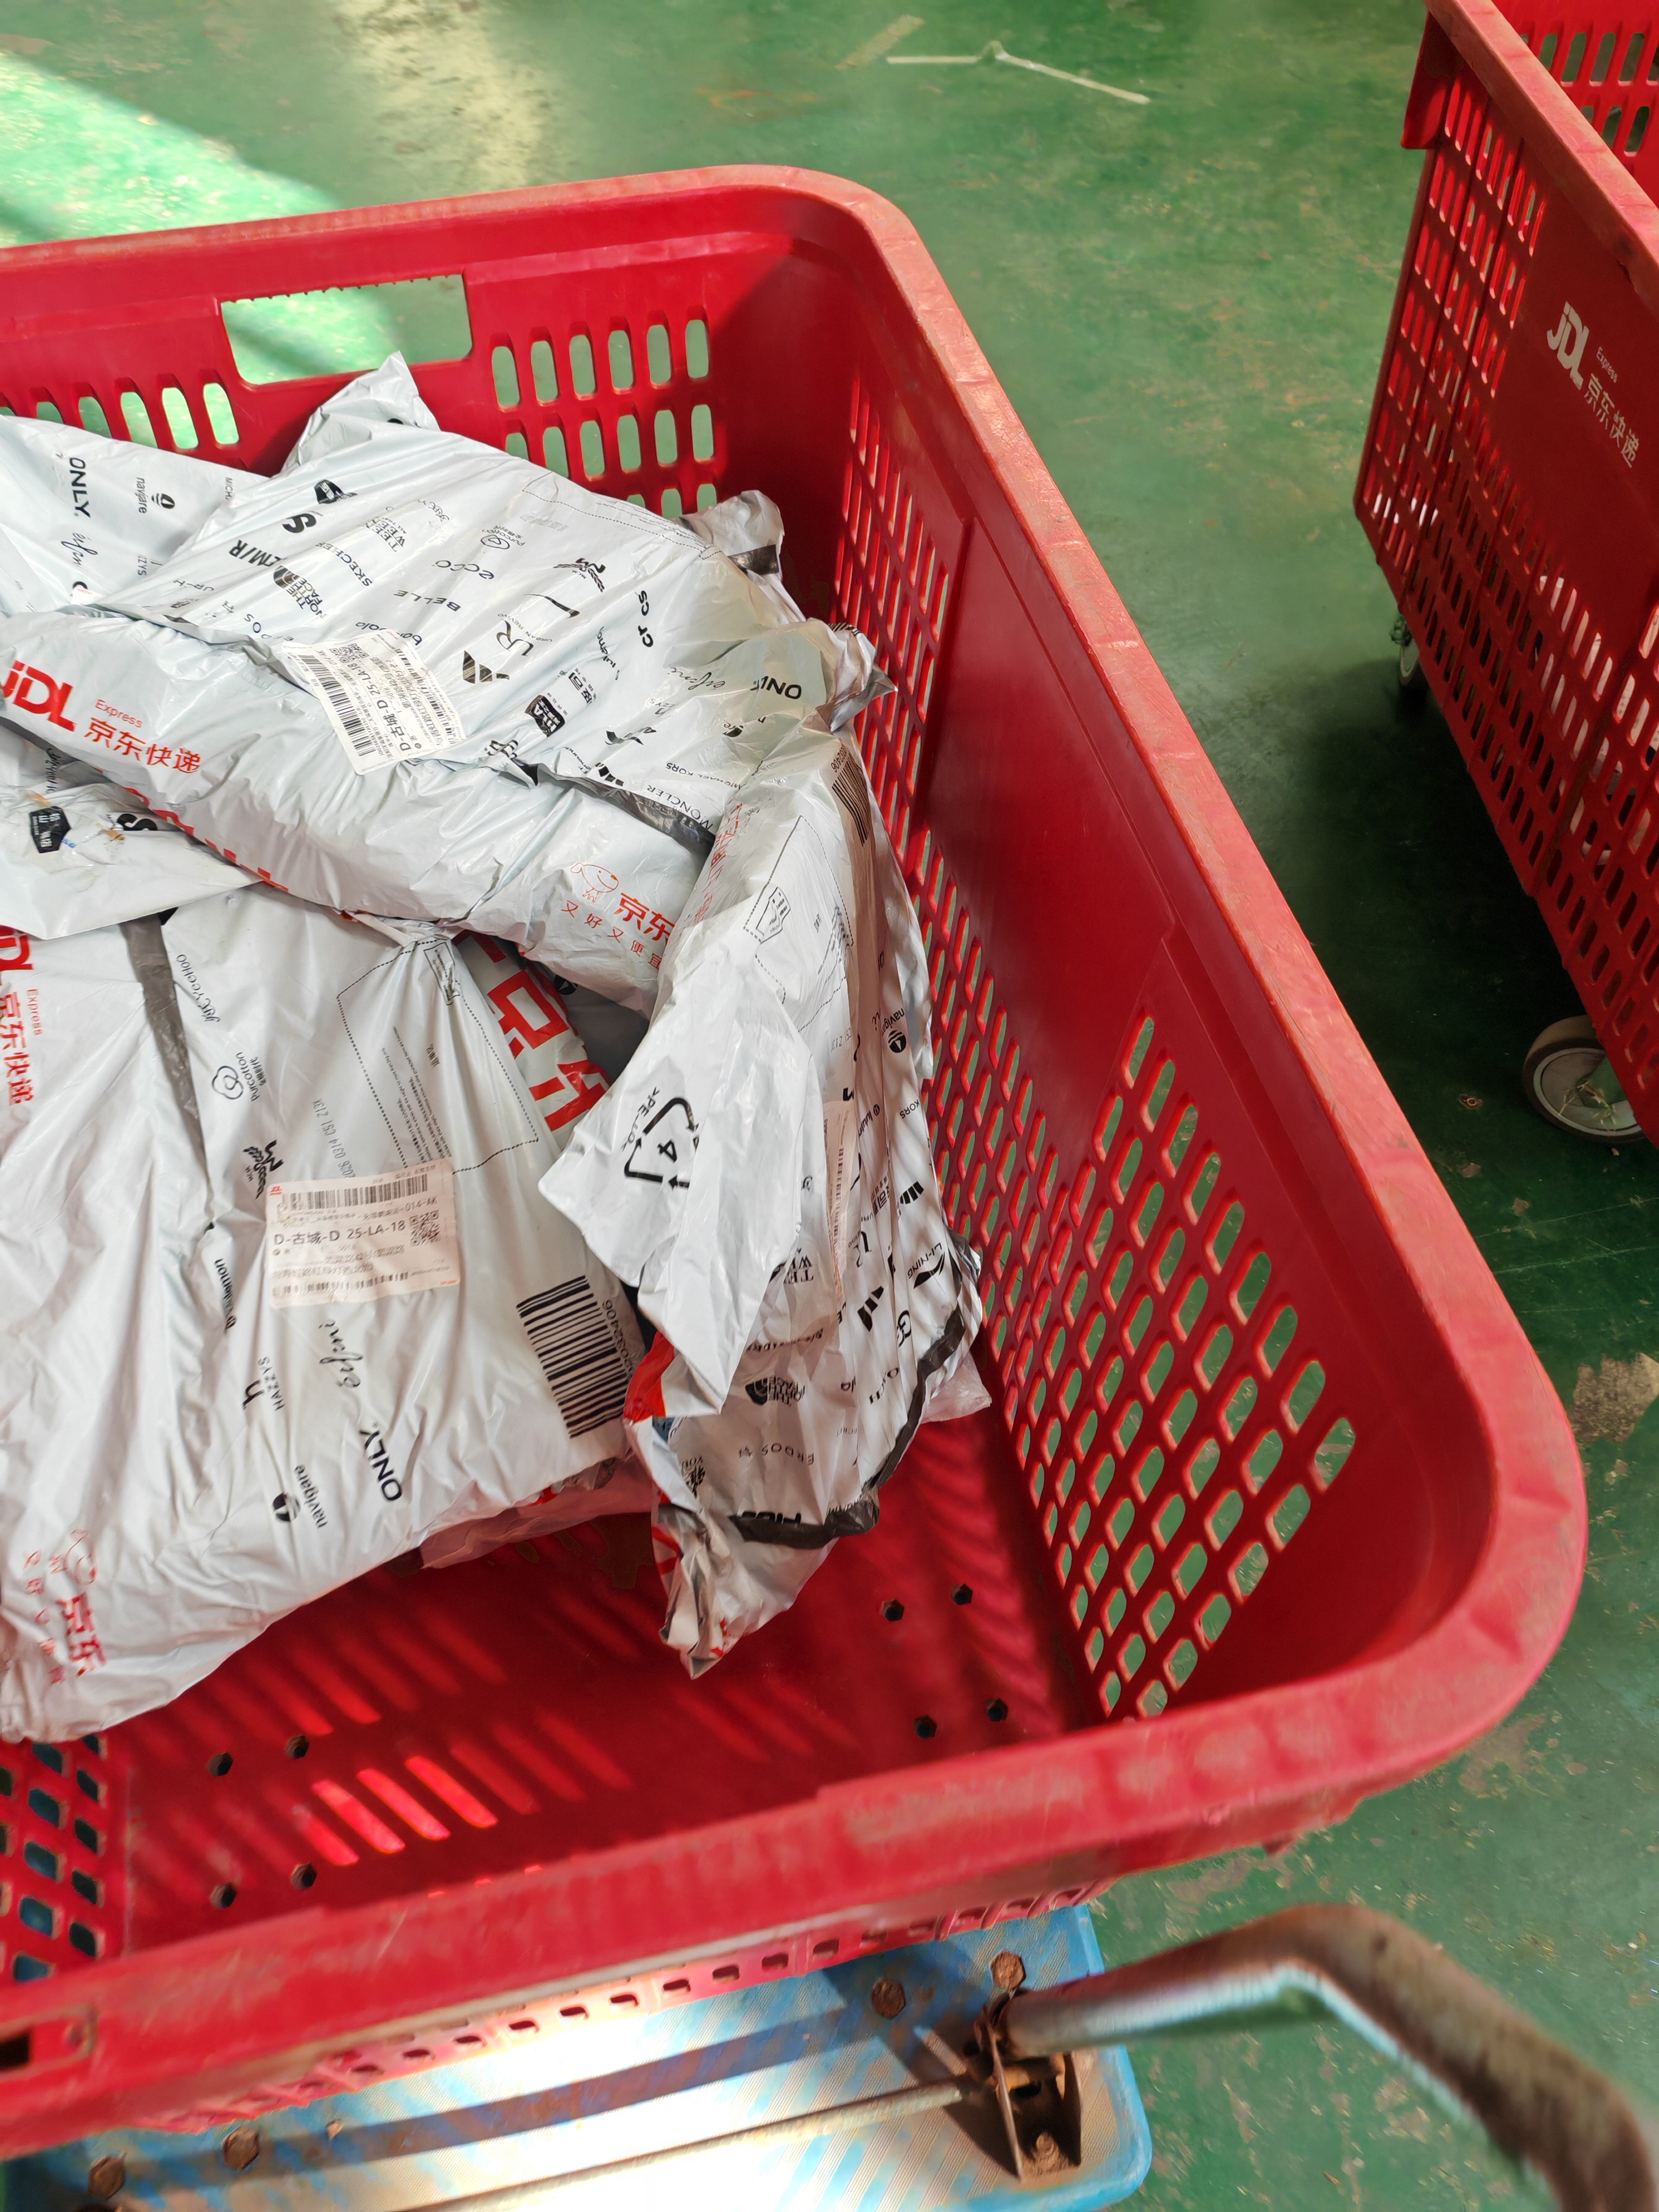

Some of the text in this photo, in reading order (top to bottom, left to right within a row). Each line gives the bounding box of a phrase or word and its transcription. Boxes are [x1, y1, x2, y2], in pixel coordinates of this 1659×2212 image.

[1547, 301, 1589, 390] JDL
[1596, 346, 1618, 383] Express
[1584, 373, 1639, 468] 京东快递
[69, 457, 91, 518] ONLY
[136, 477, 147, 514] navigare
[572, 570, 586, 579] MCM
[393, 589, 461, 612] BELLE
[347, 663, 380, 696] 25-LA-18
[95, 699, 144, 728] Express
[377, 699, 412, 751] D-古城-D
[83, 717, 202, 774] 京东快递
[665, 762, 694, 777] KORS
[646, 783, 714, 832] MONCLER
[613, 892, 676, 946] 京东
[26, 988, 43, 1036] Express
[0, 992, 35, 1106] 京东快递
[899, 1098, 920, 1120] KORS
[657, 1138, 678, 1164] 4
[274, 1220, 406, 1245] D-古城-D 25-LA-18
[907, 1242, 943, 1279] LI-NING
[257, 1356, 286, 1411] HAZZYS
[359, 1428, 402, 1502] ONLY
